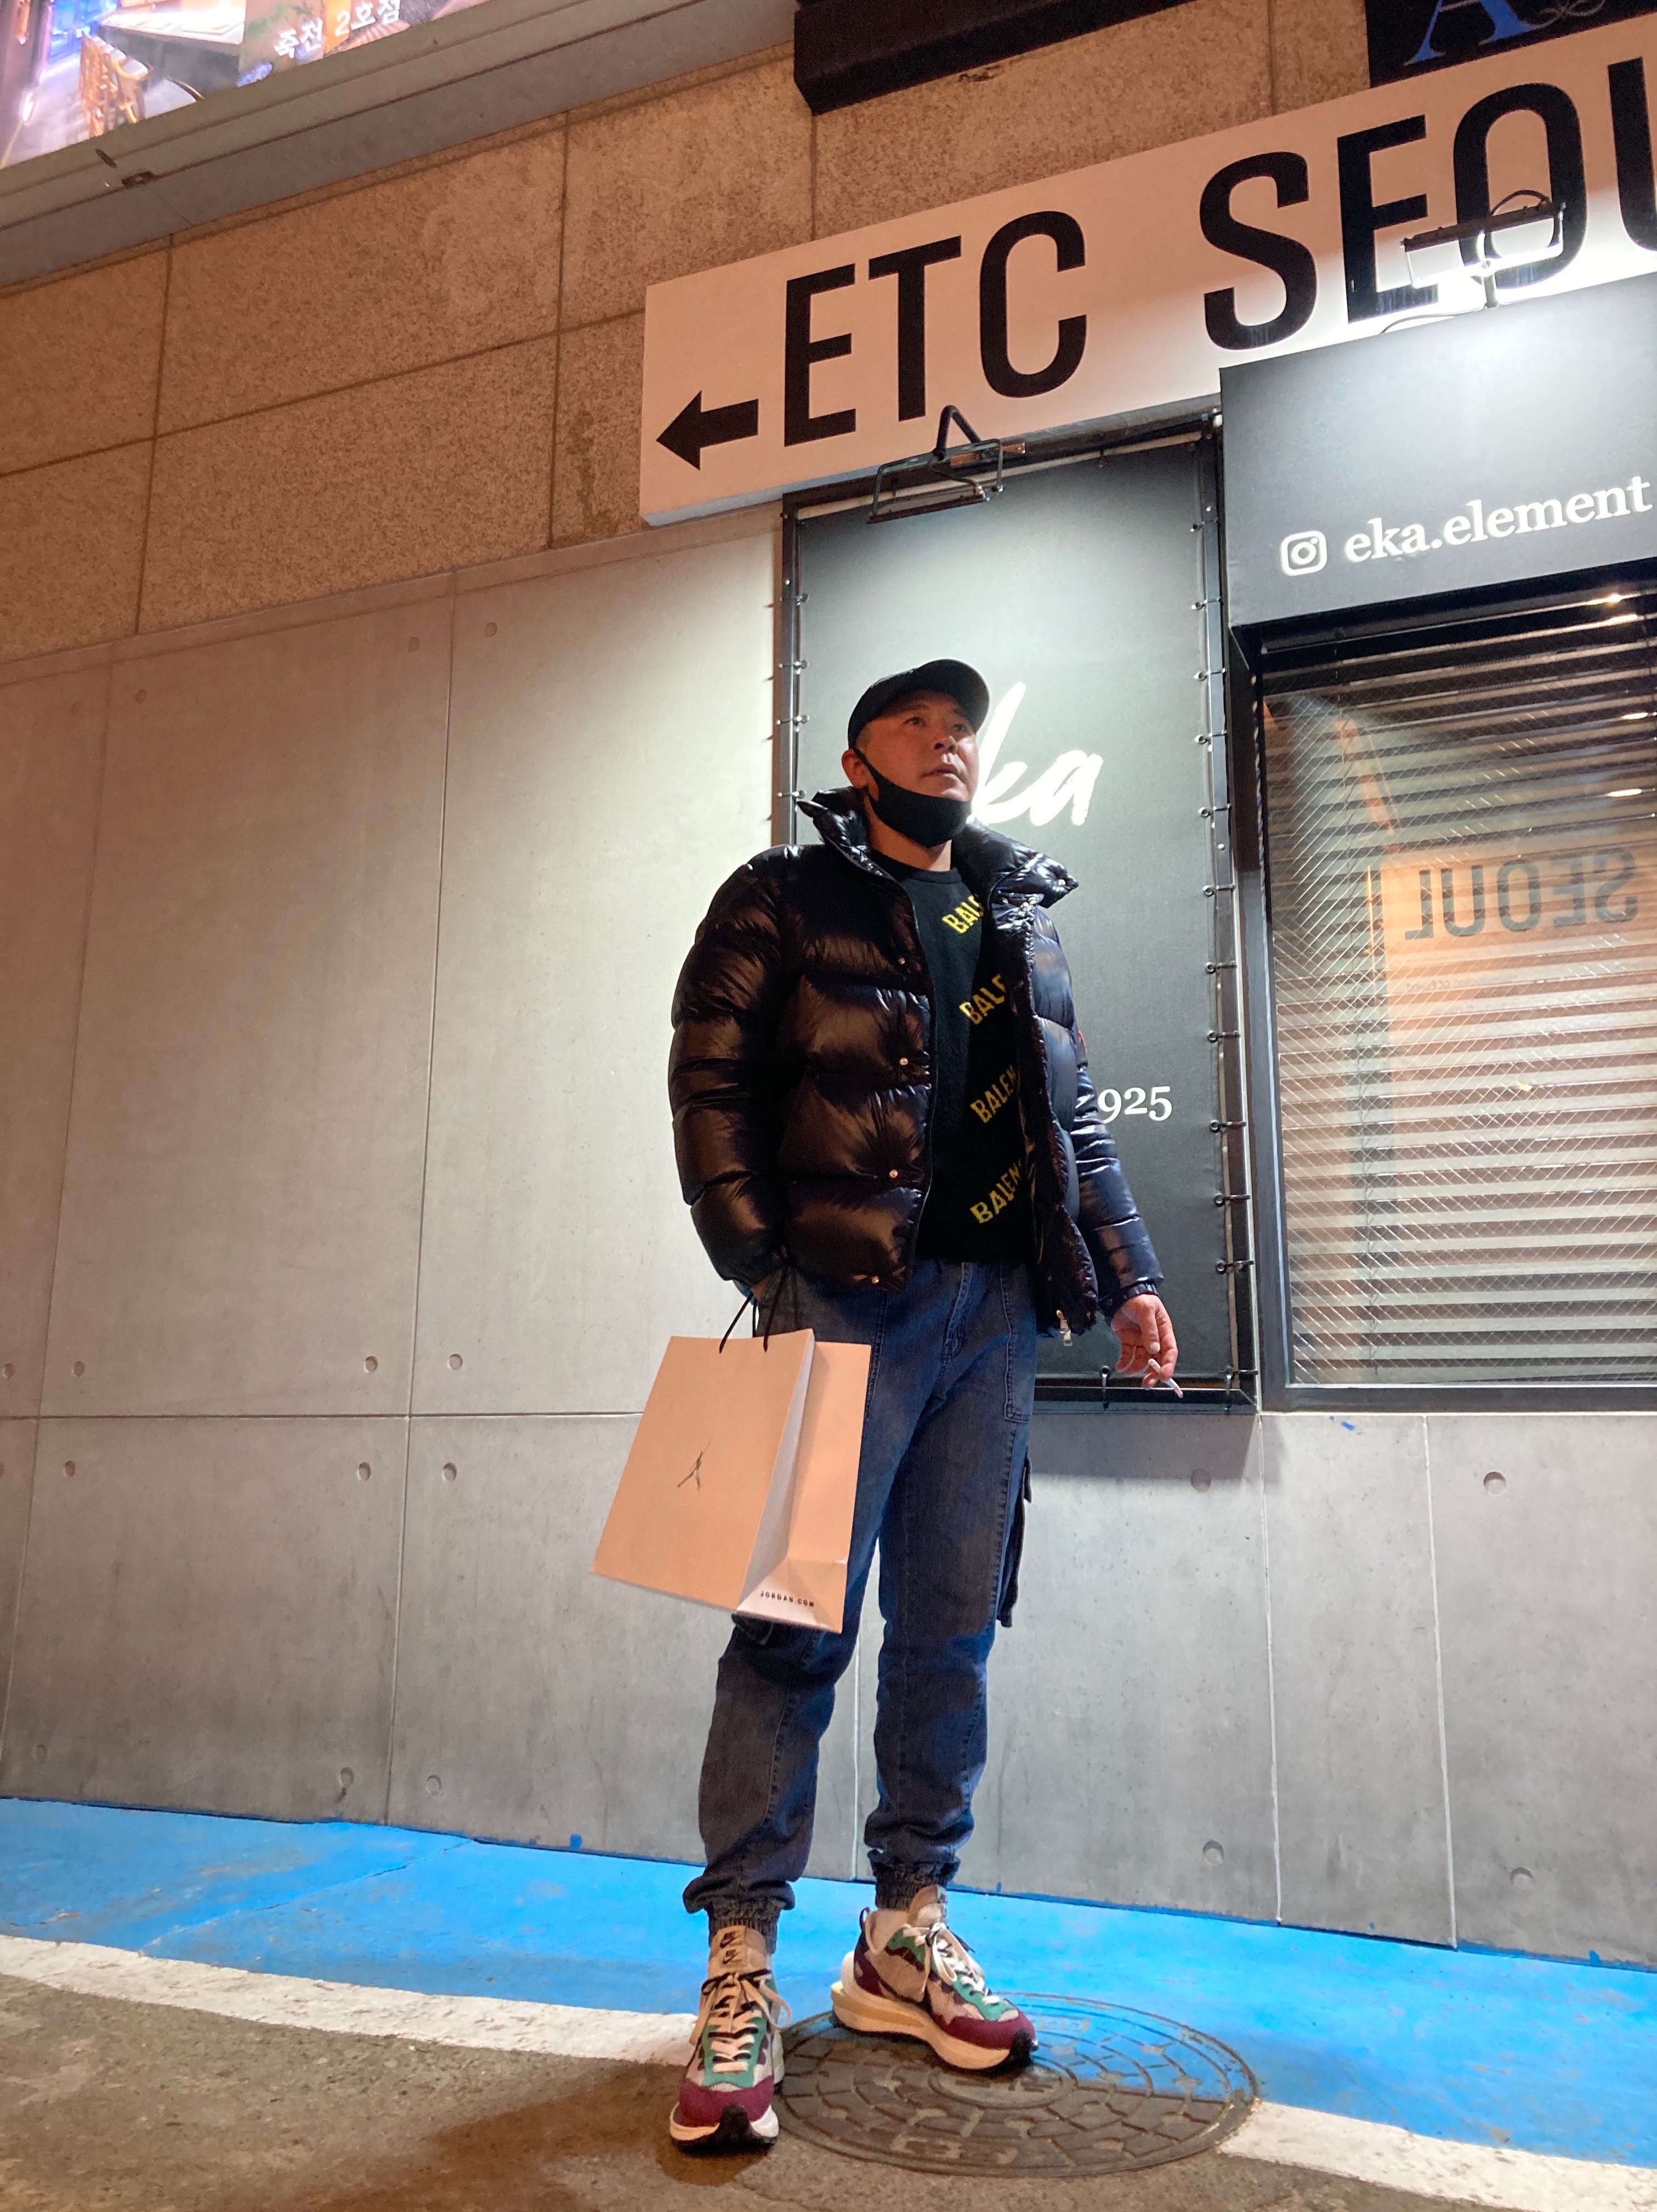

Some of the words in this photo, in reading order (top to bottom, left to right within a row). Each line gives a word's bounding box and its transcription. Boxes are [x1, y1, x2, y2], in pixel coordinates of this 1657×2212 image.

[274, 17, 324, 59] 죽전
[334, 0, 401, 37] 2호점
[784, 211, 1087, 447] ETC
[1344, 475, 1653, 563] eka.element
[966, 681, 1104, 827] ka
[1098, 1085, 1172, 1124] 925
[969, 1158, 1023, 1224] BALEN
[760, 1590, 815, 1608] JORDAN.COM
